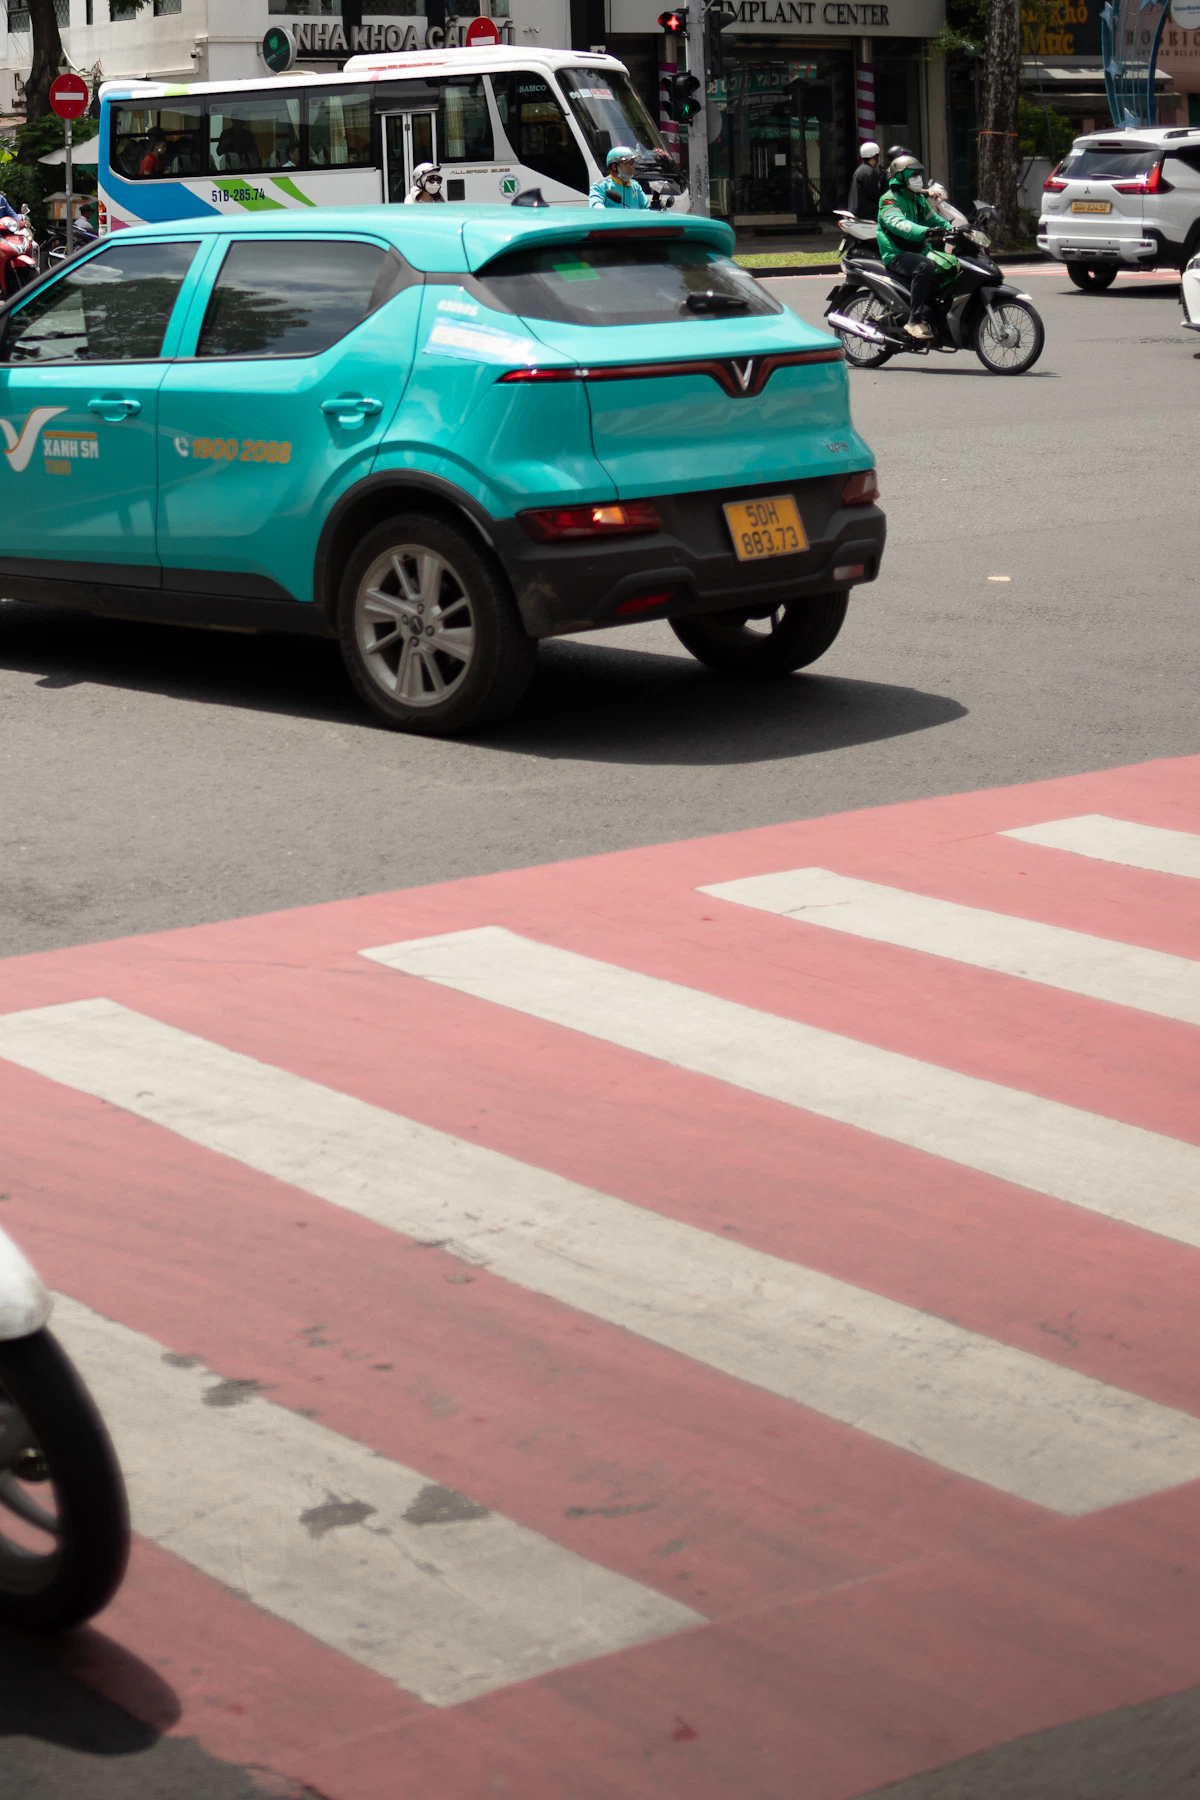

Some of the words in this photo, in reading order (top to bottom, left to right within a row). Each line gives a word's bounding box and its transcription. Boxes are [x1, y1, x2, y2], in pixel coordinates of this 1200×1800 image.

[823, 3, 890, 26] CENTER
[293, 23, 348, 50] NHA
[352, 24, 421, 51] KHOA
[519, 84, 547, 93] SAMCO
[211, 188, 265, 203] 51B-285.74
[43, 439, 79, 457] XANH
[81, 440, 99, 459] SM
[191, 437, 238, 460] 1900
[240, 440, 292, 464] 2088
[45, 459, 72, 475] TAXI
[745, 502, 780, 527] 50H
[741, 526, 799, 555] 883.73
